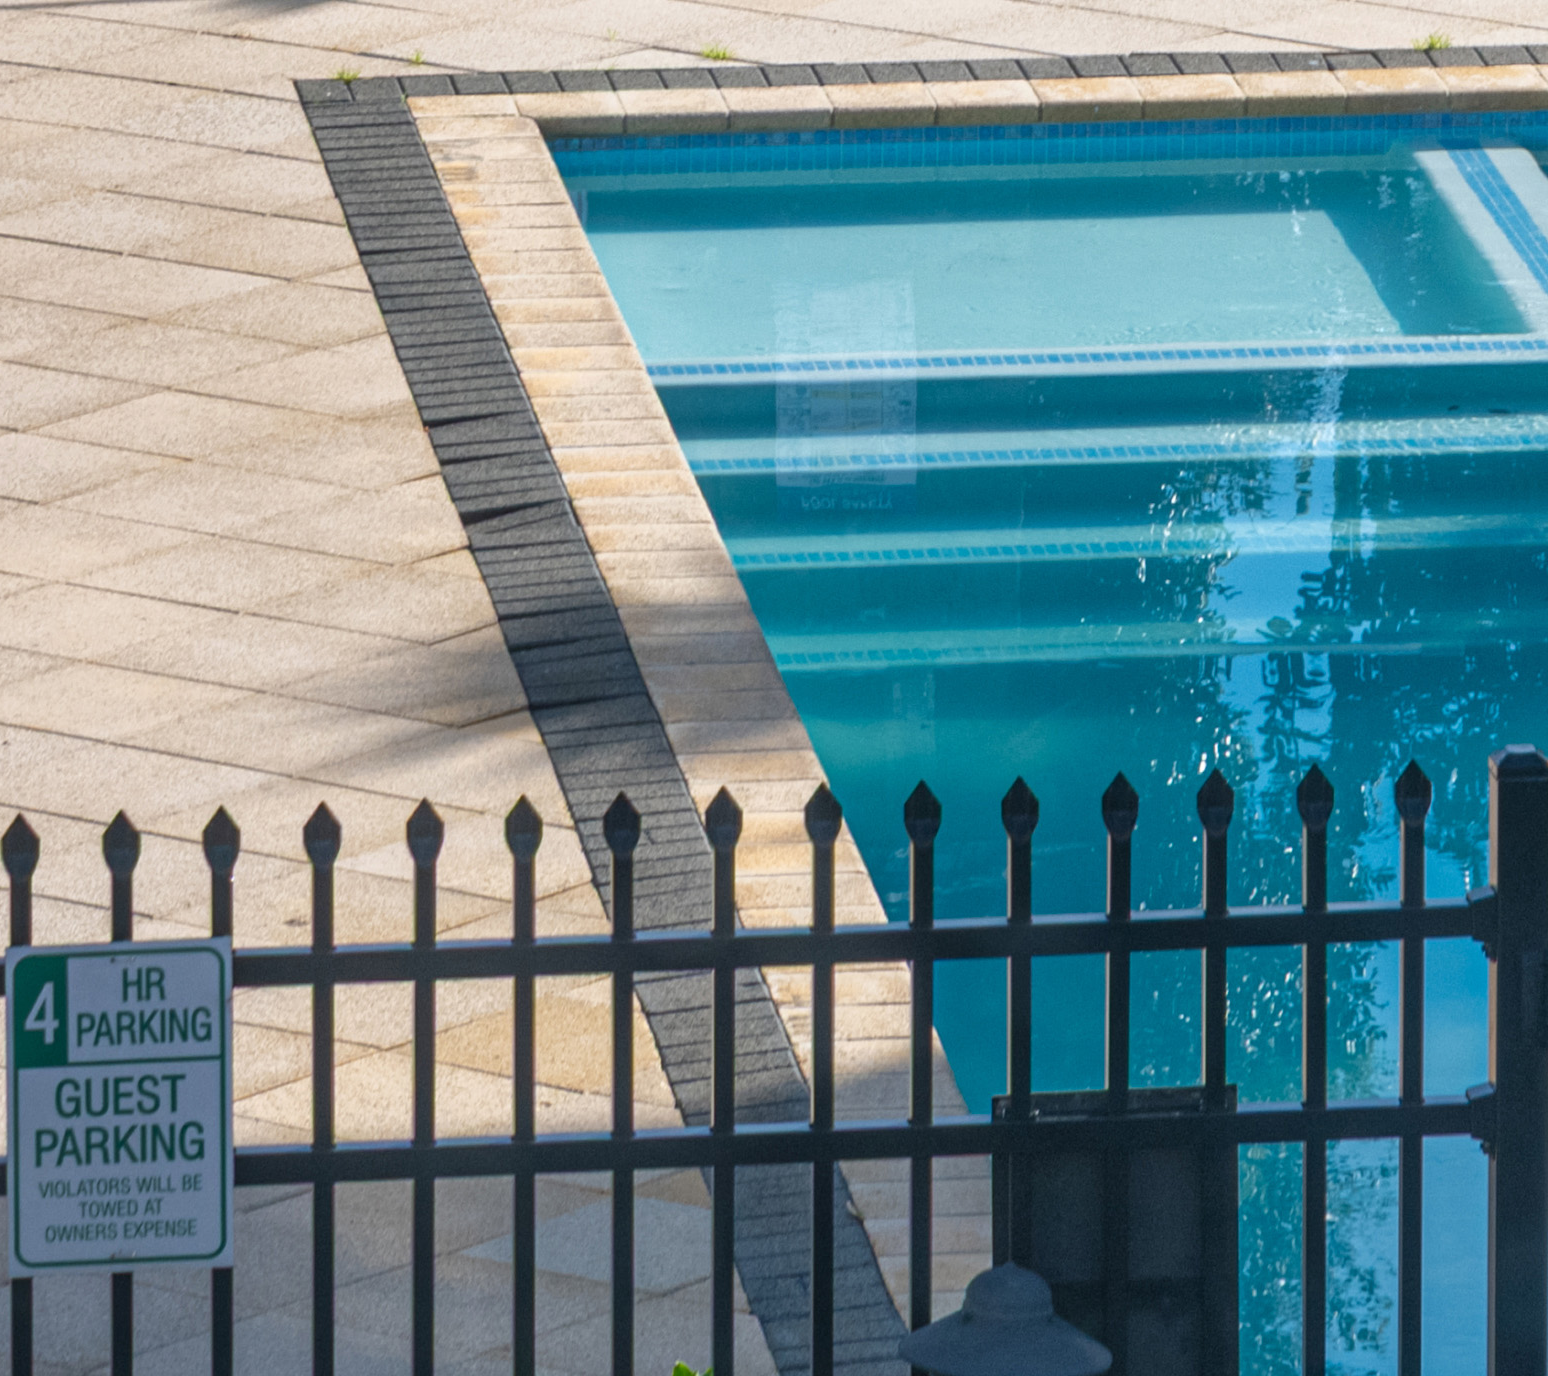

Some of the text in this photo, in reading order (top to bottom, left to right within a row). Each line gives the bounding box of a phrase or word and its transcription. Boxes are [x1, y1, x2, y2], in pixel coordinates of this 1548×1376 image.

[122, 967, 165, 1002] HR
[25, 982, 59, 1044] 4
[77, 1006, 212, 1047] PARKING
[55, 1074, 185, 1118] GUEST
[35, 1121, 204, 1167] PARKING
[38, 1173, 201, 1198] VIOLATORS WILL BE
[79, 1198, 162, 1218] TOWED AT
[45, 1219, 196, 1243] OWNERS EXPENSE
